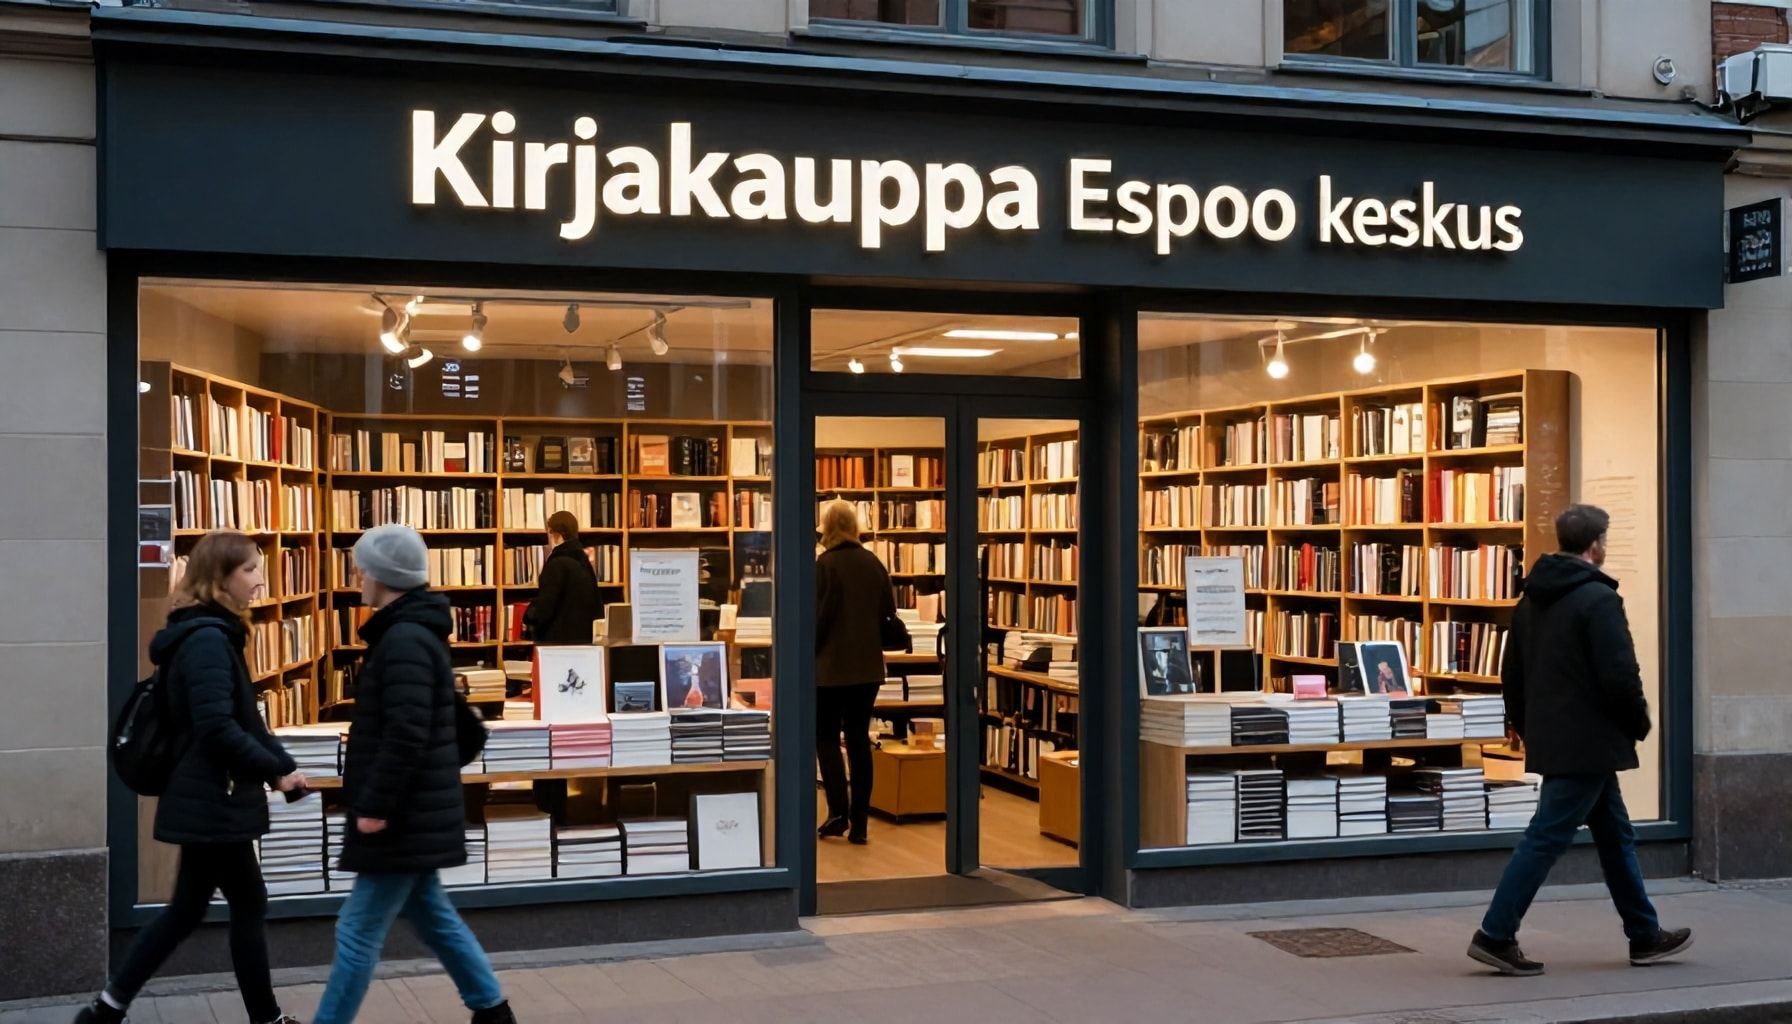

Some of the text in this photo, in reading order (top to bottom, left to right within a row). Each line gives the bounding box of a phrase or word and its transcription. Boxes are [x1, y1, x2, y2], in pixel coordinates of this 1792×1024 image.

[411, 109, 1524, 255] Kirjakauppa Espoo keskus
